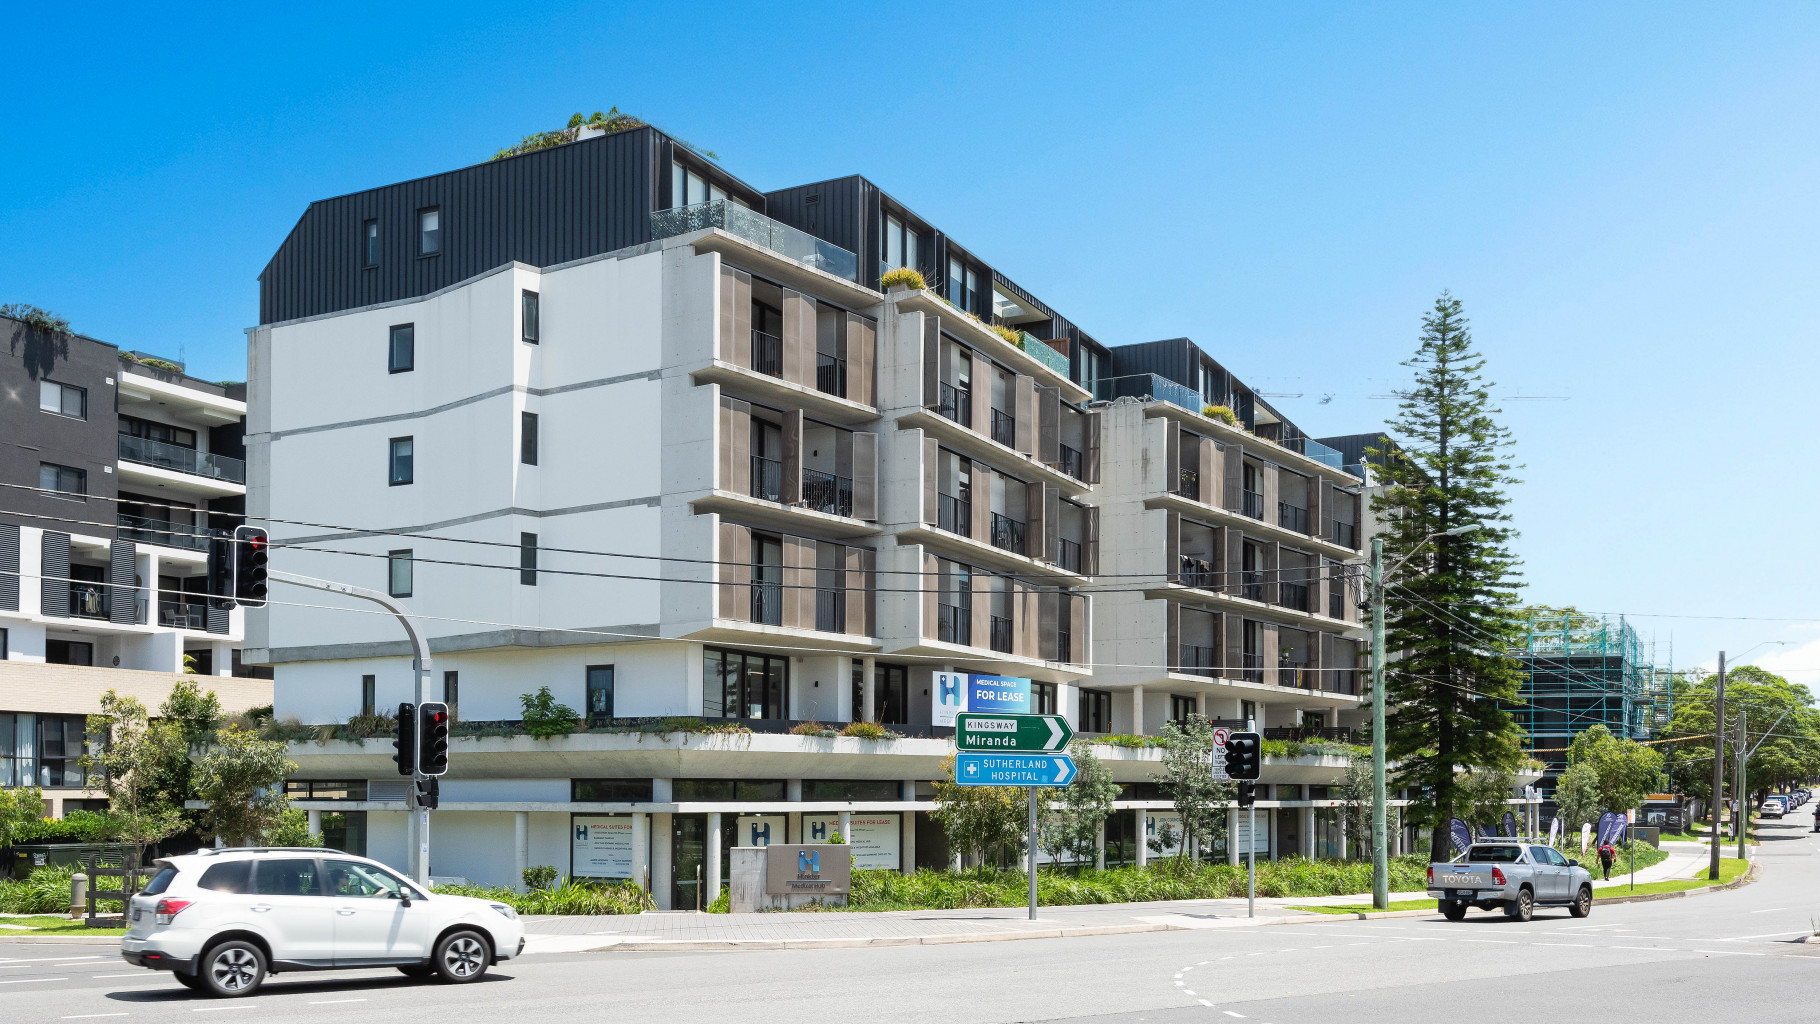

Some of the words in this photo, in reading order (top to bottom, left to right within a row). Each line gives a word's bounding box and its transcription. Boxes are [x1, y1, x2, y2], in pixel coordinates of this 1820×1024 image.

[976, 679, 1000, 687] MEDICAL
[1000, 680, 1017, 688] SPACE
[976, 690, 995, 701] FOR
[997, 691, 1025, 702] LEASE
[967, 721, 1015, 730] KINGSWAY
[966, 734, 1017, 747] Miranda
[983, 759, 1047, 769] SUTHERLAND
[991, 771, 1039, 781] HOSPITAL
[1442, 875, 1482, 884] TOYOTA
